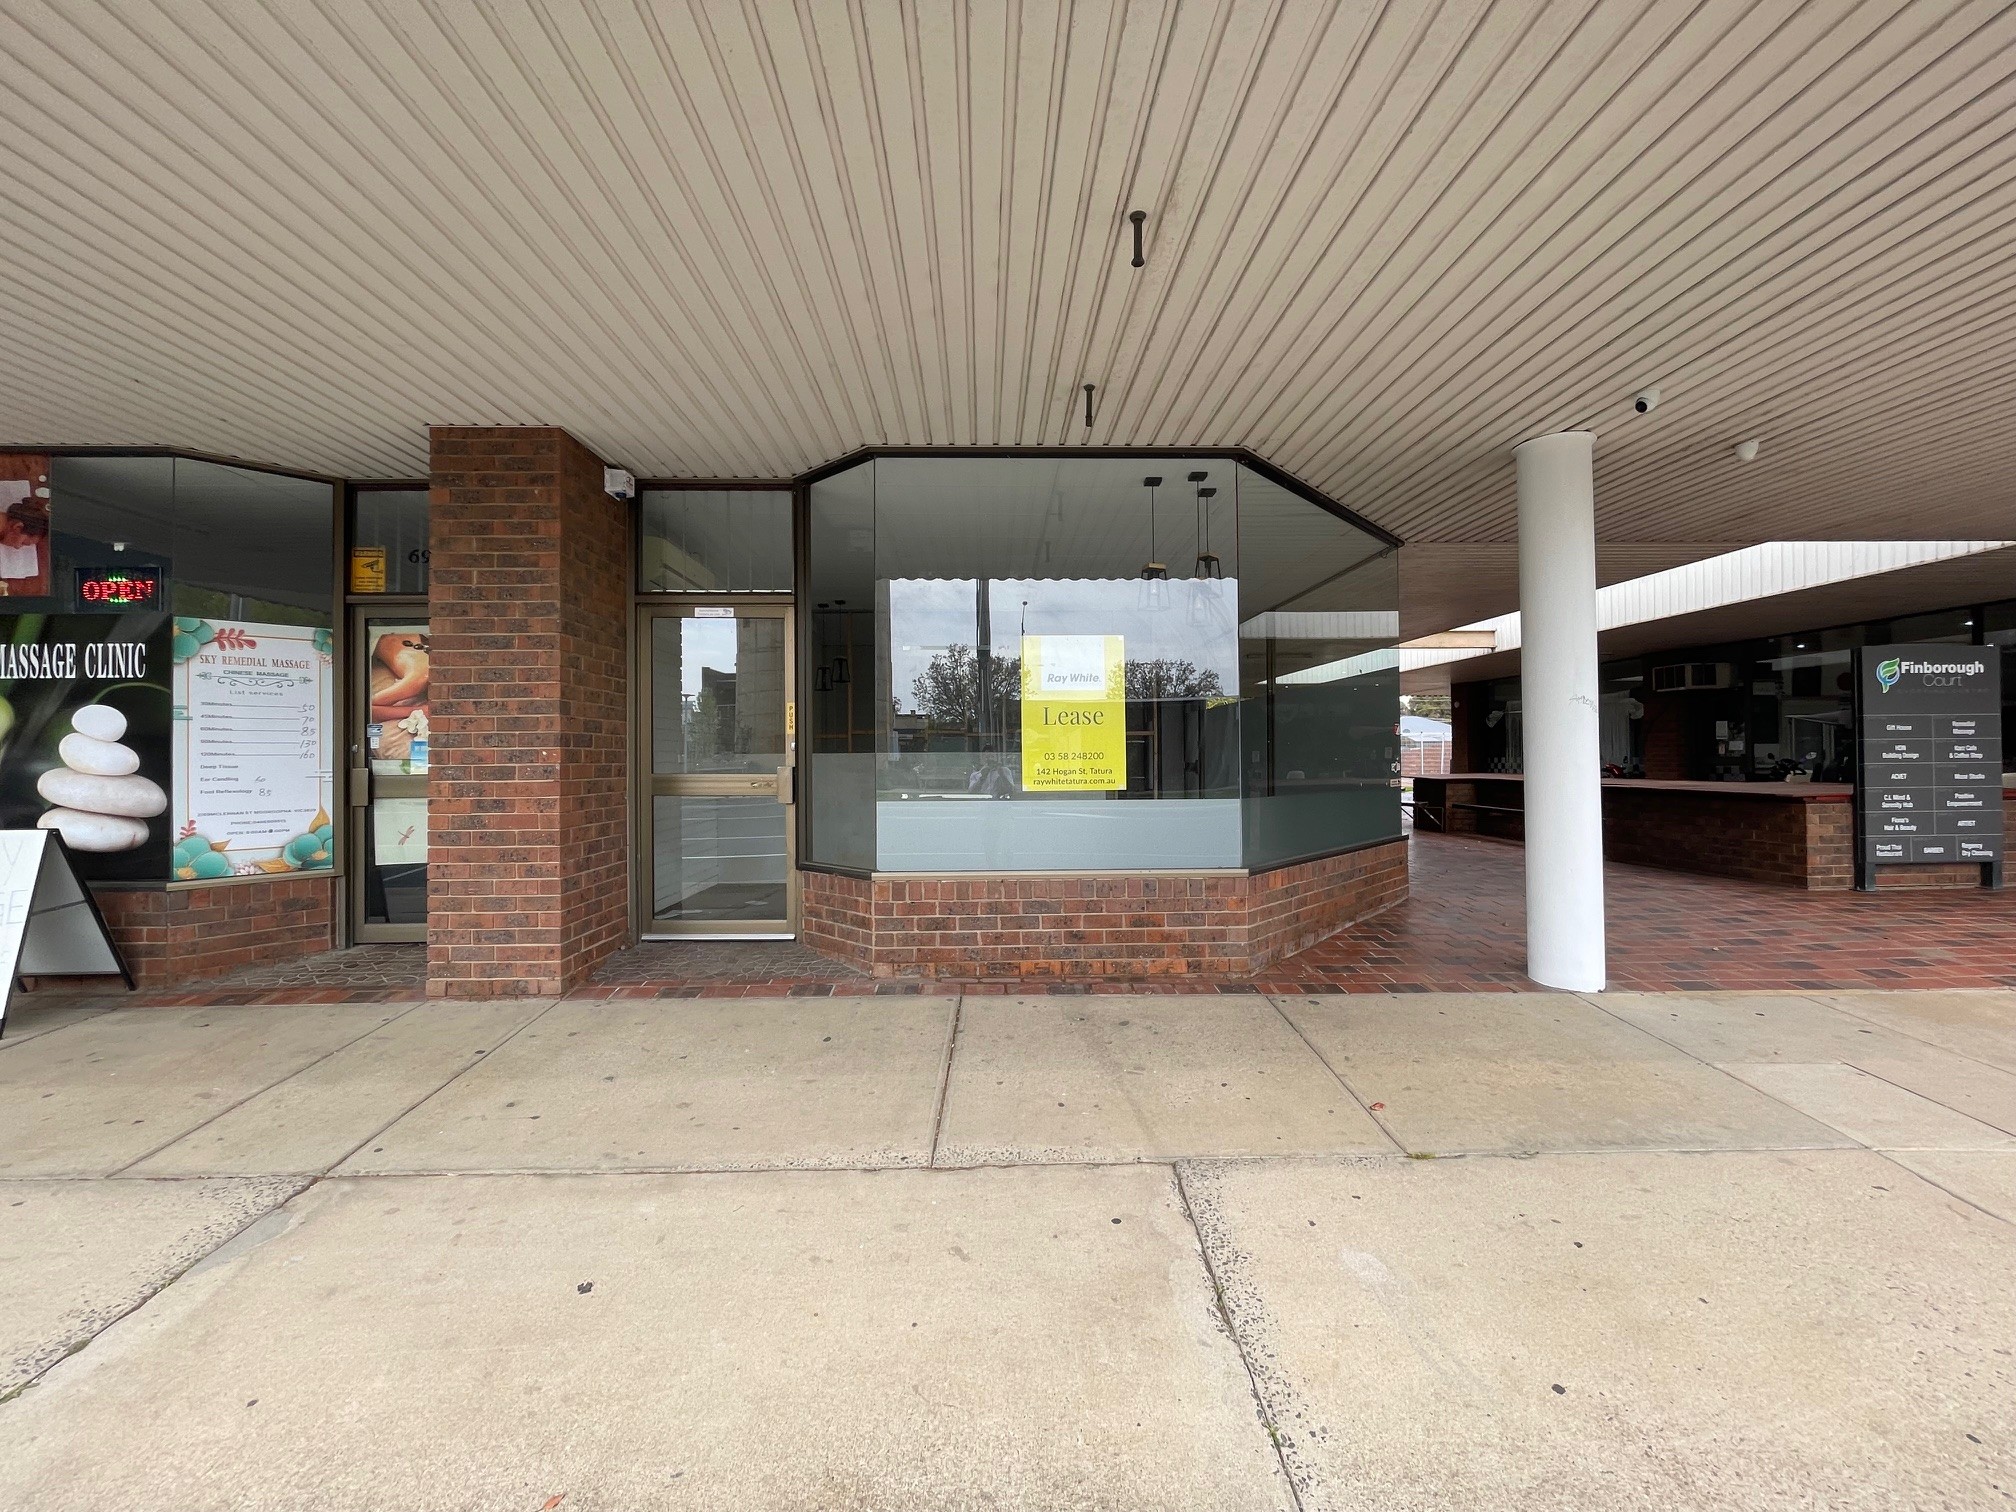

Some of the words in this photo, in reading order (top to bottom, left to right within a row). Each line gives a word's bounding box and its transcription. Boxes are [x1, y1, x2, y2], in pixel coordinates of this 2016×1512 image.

[82, 580, 154, 601] OPEN
[84, 642, 147, 680] CLINIC
[199, 654, 218, 665] SKY
[221, 656, 268, 668] REMEDIAL
[271, 658, 311, 670] MASSAGE
[1900, 661, 1985, 676] Finborough
[1047, 673, 1068, 685] Ray
[1922, 673, 1963, 687] Court
[301, 716, 315, 726] 70
[1043, 706, 1104, 726] Lease
[300, 726, 316, 737] 85
[300, 739, 317, 749] 130
[300, 749, 316, 759] 160
[1044, 752, 1056, 761] 03
[1058, 752, 1069, 761] 58
[1071, 752, 1105, 761] 248200
[1036, 768, 1051, 776] 142
[1052, 768, 1077, 778] Hogan
[1090, 768, 1113, 776] Tatura
[1033, 777, 1116, 786] raywhitetatura.com.au
[258, 788, 272, 797] 85
